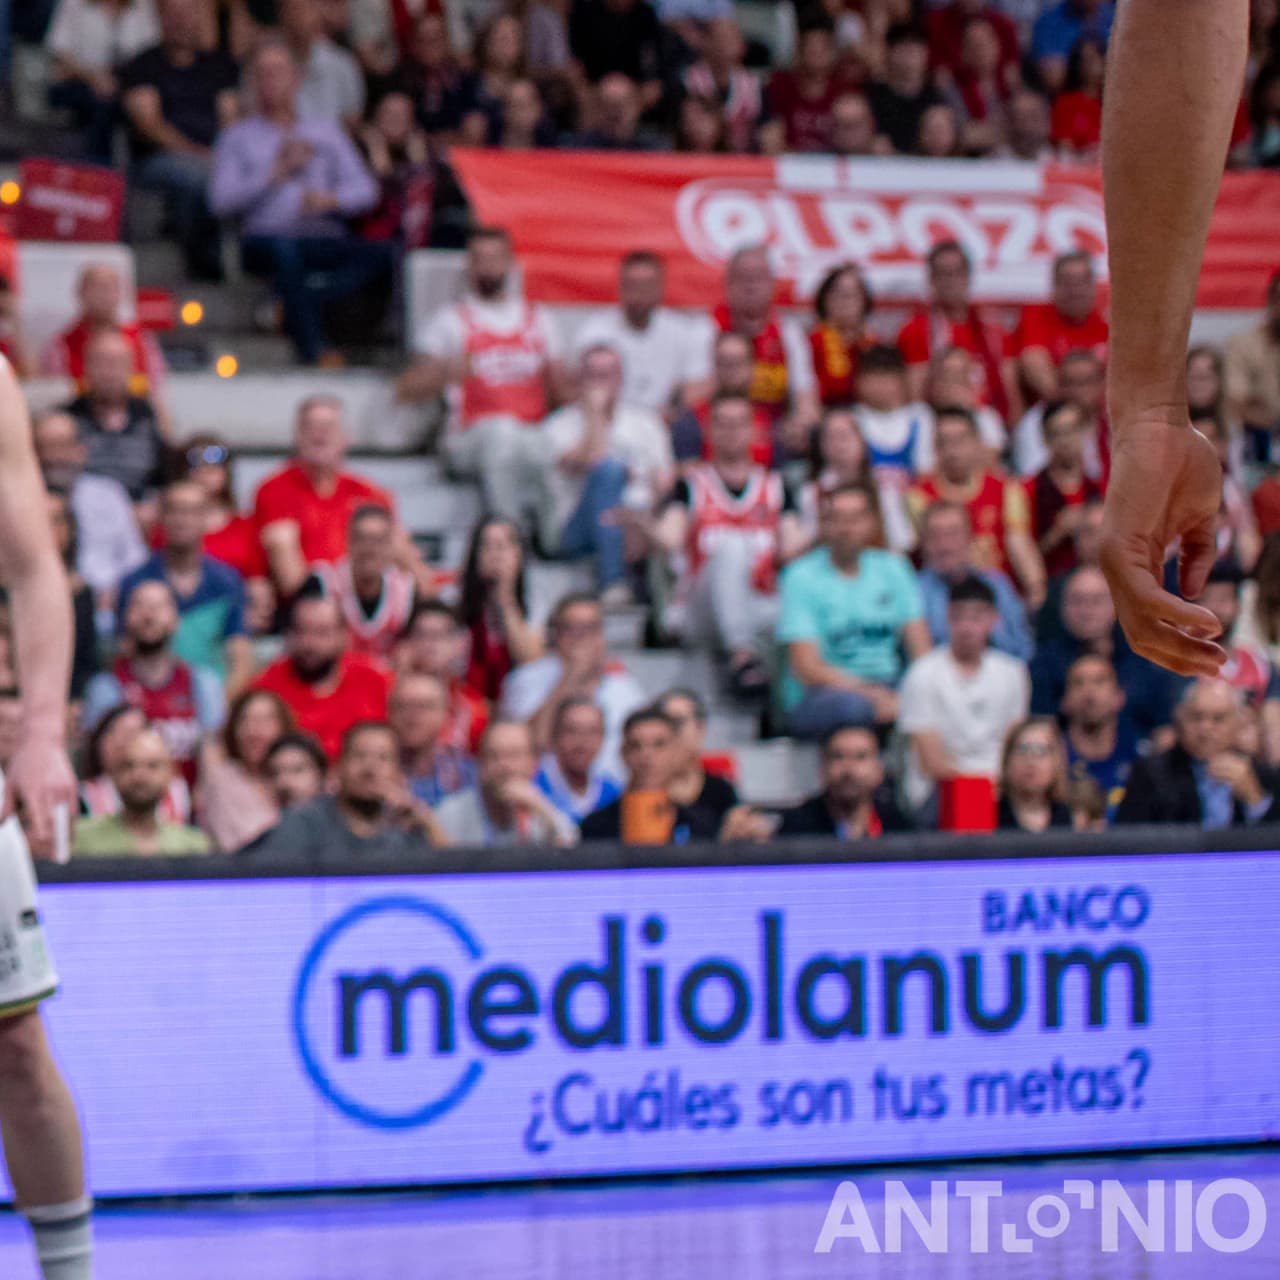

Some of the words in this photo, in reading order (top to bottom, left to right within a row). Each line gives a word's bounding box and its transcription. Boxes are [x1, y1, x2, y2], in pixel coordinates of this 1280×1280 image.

[982, 883, 1150, 934] BANCO
[336, 908, 1150, 1057] mediolanum
[522, 1065, 738, 1154] ¿Cuáles
[758, 1077, 853, 1128] son
[870, 1062, 950, 1121] tus
[965, 1046, 1151, 1116] metas?
